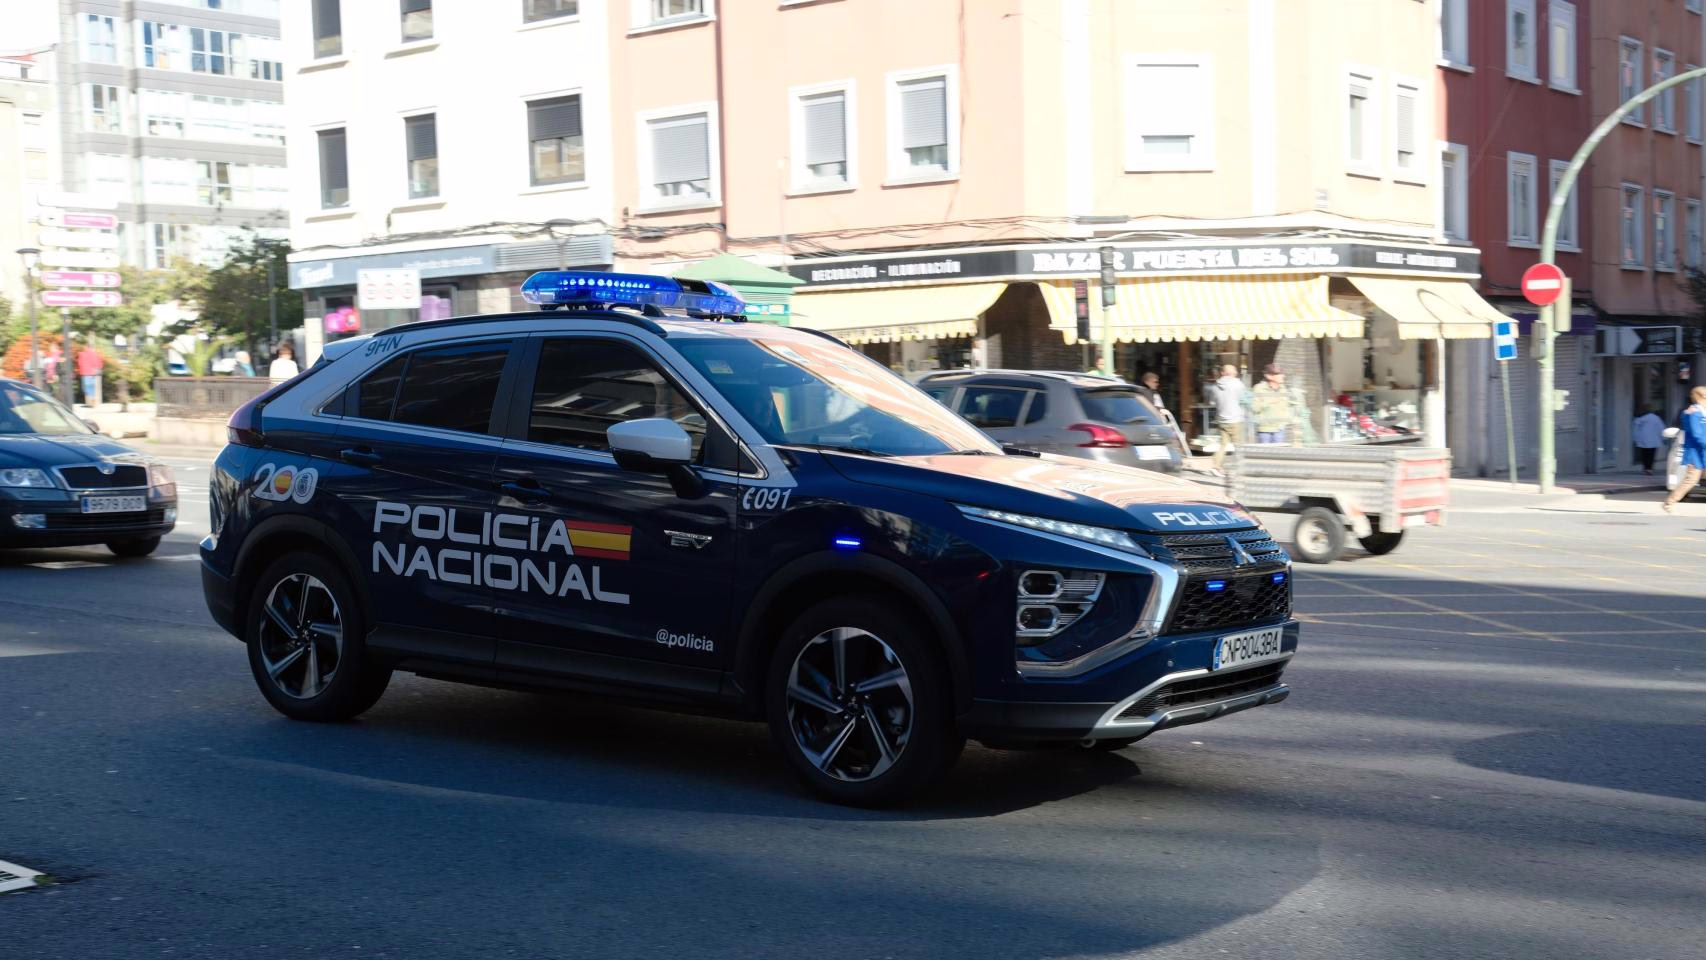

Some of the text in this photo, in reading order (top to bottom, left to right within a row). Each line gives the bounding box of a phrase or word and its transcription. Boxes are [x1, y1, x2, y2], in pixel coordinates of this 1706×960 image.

[1132, 249, 1236, 270] PUERTA
[1238, 247, 1288, 267] DEL
[1289, 246, 1340, 266] SOL
[365, 335, 405, 357] 9HN
[253, 463, 319, 505] 200
[372, 540, 630, 605] NACIONAL
[656, 628, 714, 652] @policia
[1221, 631, 1279, 664] CNP8043BA
